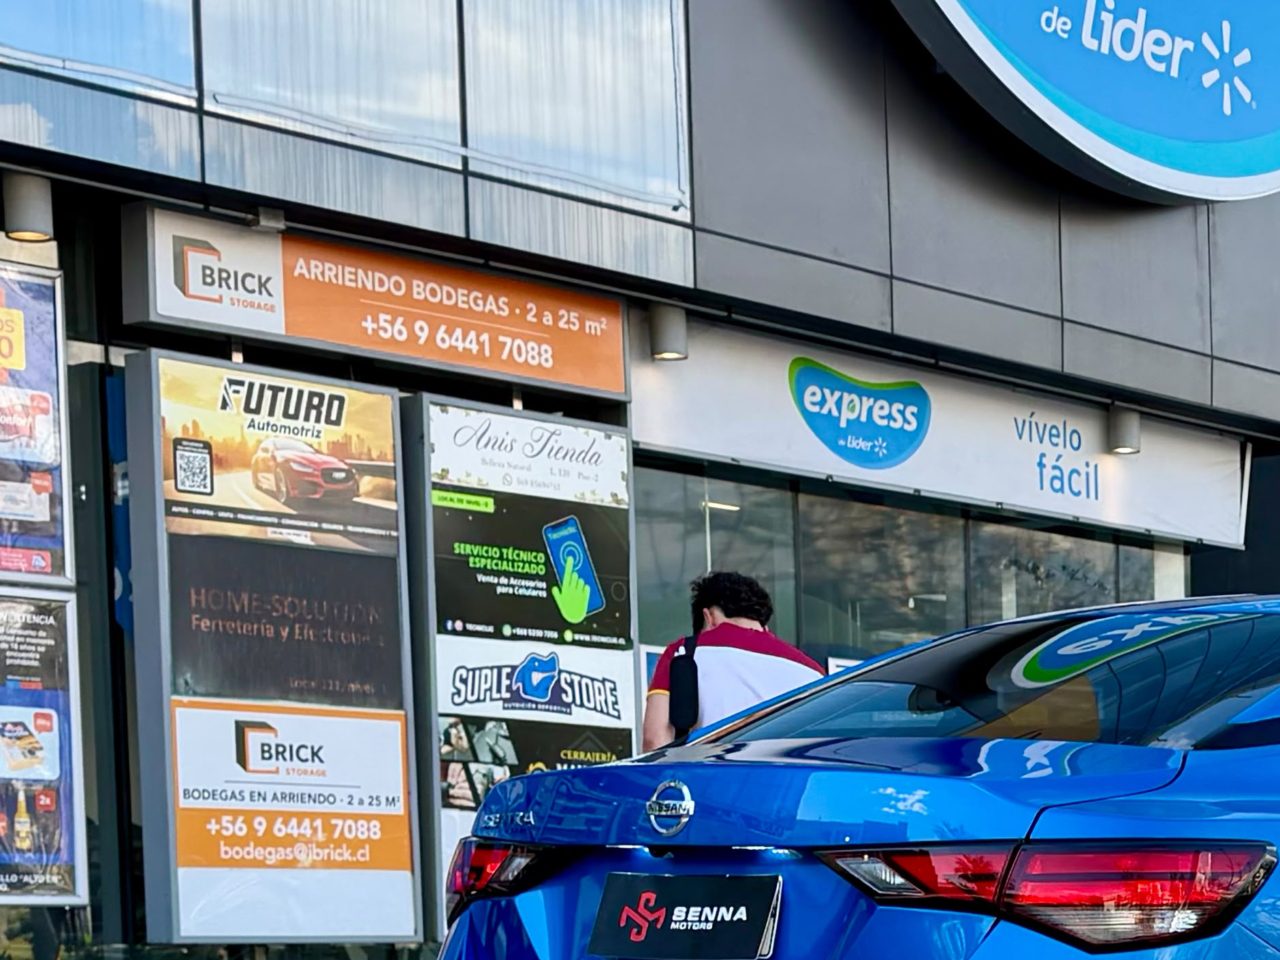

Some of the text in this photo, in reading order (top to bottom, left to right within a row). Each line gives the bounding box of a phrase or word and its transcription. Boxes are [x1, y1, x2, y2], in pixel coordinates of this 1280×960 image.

[1040, 6, 1072, 38] de
[200, 264, 274, 298] BRICK
[229, 296, 277, 314] STORAGE
[293, 257, 406, 297] ARRIENDO
[412, 279, 509, 317] BODEGAS
[526, 302, 538, 323] 2
[542, 311, 554, 326] a
[558, 308, 580, 332] 25
[361, 312, 554, 369] +56 9 6441 7088
[219, 376, 346, 428] FUTURO
[803, 384, 919, 433] express
[246, 417, 322, 440] Automotriz
[1013, 411, 1082, 451] vívelo
[453, 417, 604, 467] Anis Tienda
[847, 434, 874, 454] Lider
[1036, 453, 1099, 501] fácil
[453, 542, 545, 564] SERVICIO TÉCNICO
[468, 556, 546, 576] ESPECIALIZADO
[476, 573, 547, 589] Venta de Accesorios
[496, 585, 548, 598] para Celulares
[191, 614, 275, 639] Ferretería
[280, 625, 289, 643] y
[452, 666, 621, 719] SUPLE STORE
[260, 742, 325, 764] BRICK
[560, 749, 617, 763] CERRAJERÍA
[286, 767, 328, 778] STORAGE
[183, 788, 246, 802] BODEGAS
[250, 790, 267, 803] EN
[271, 791, 337, 806] ARRIENDO
[347, 795, 354, 806] 2
[358, 797, 365, 806] a
[368, 795, 382, 807] 25
[646, 800, 692, 816] NISSAN
[206, 815, 382, 840] +56 9 6441 7088
[671, 906, 748, 922] SENNA
[670, 921, 713, 931] MOTORS
